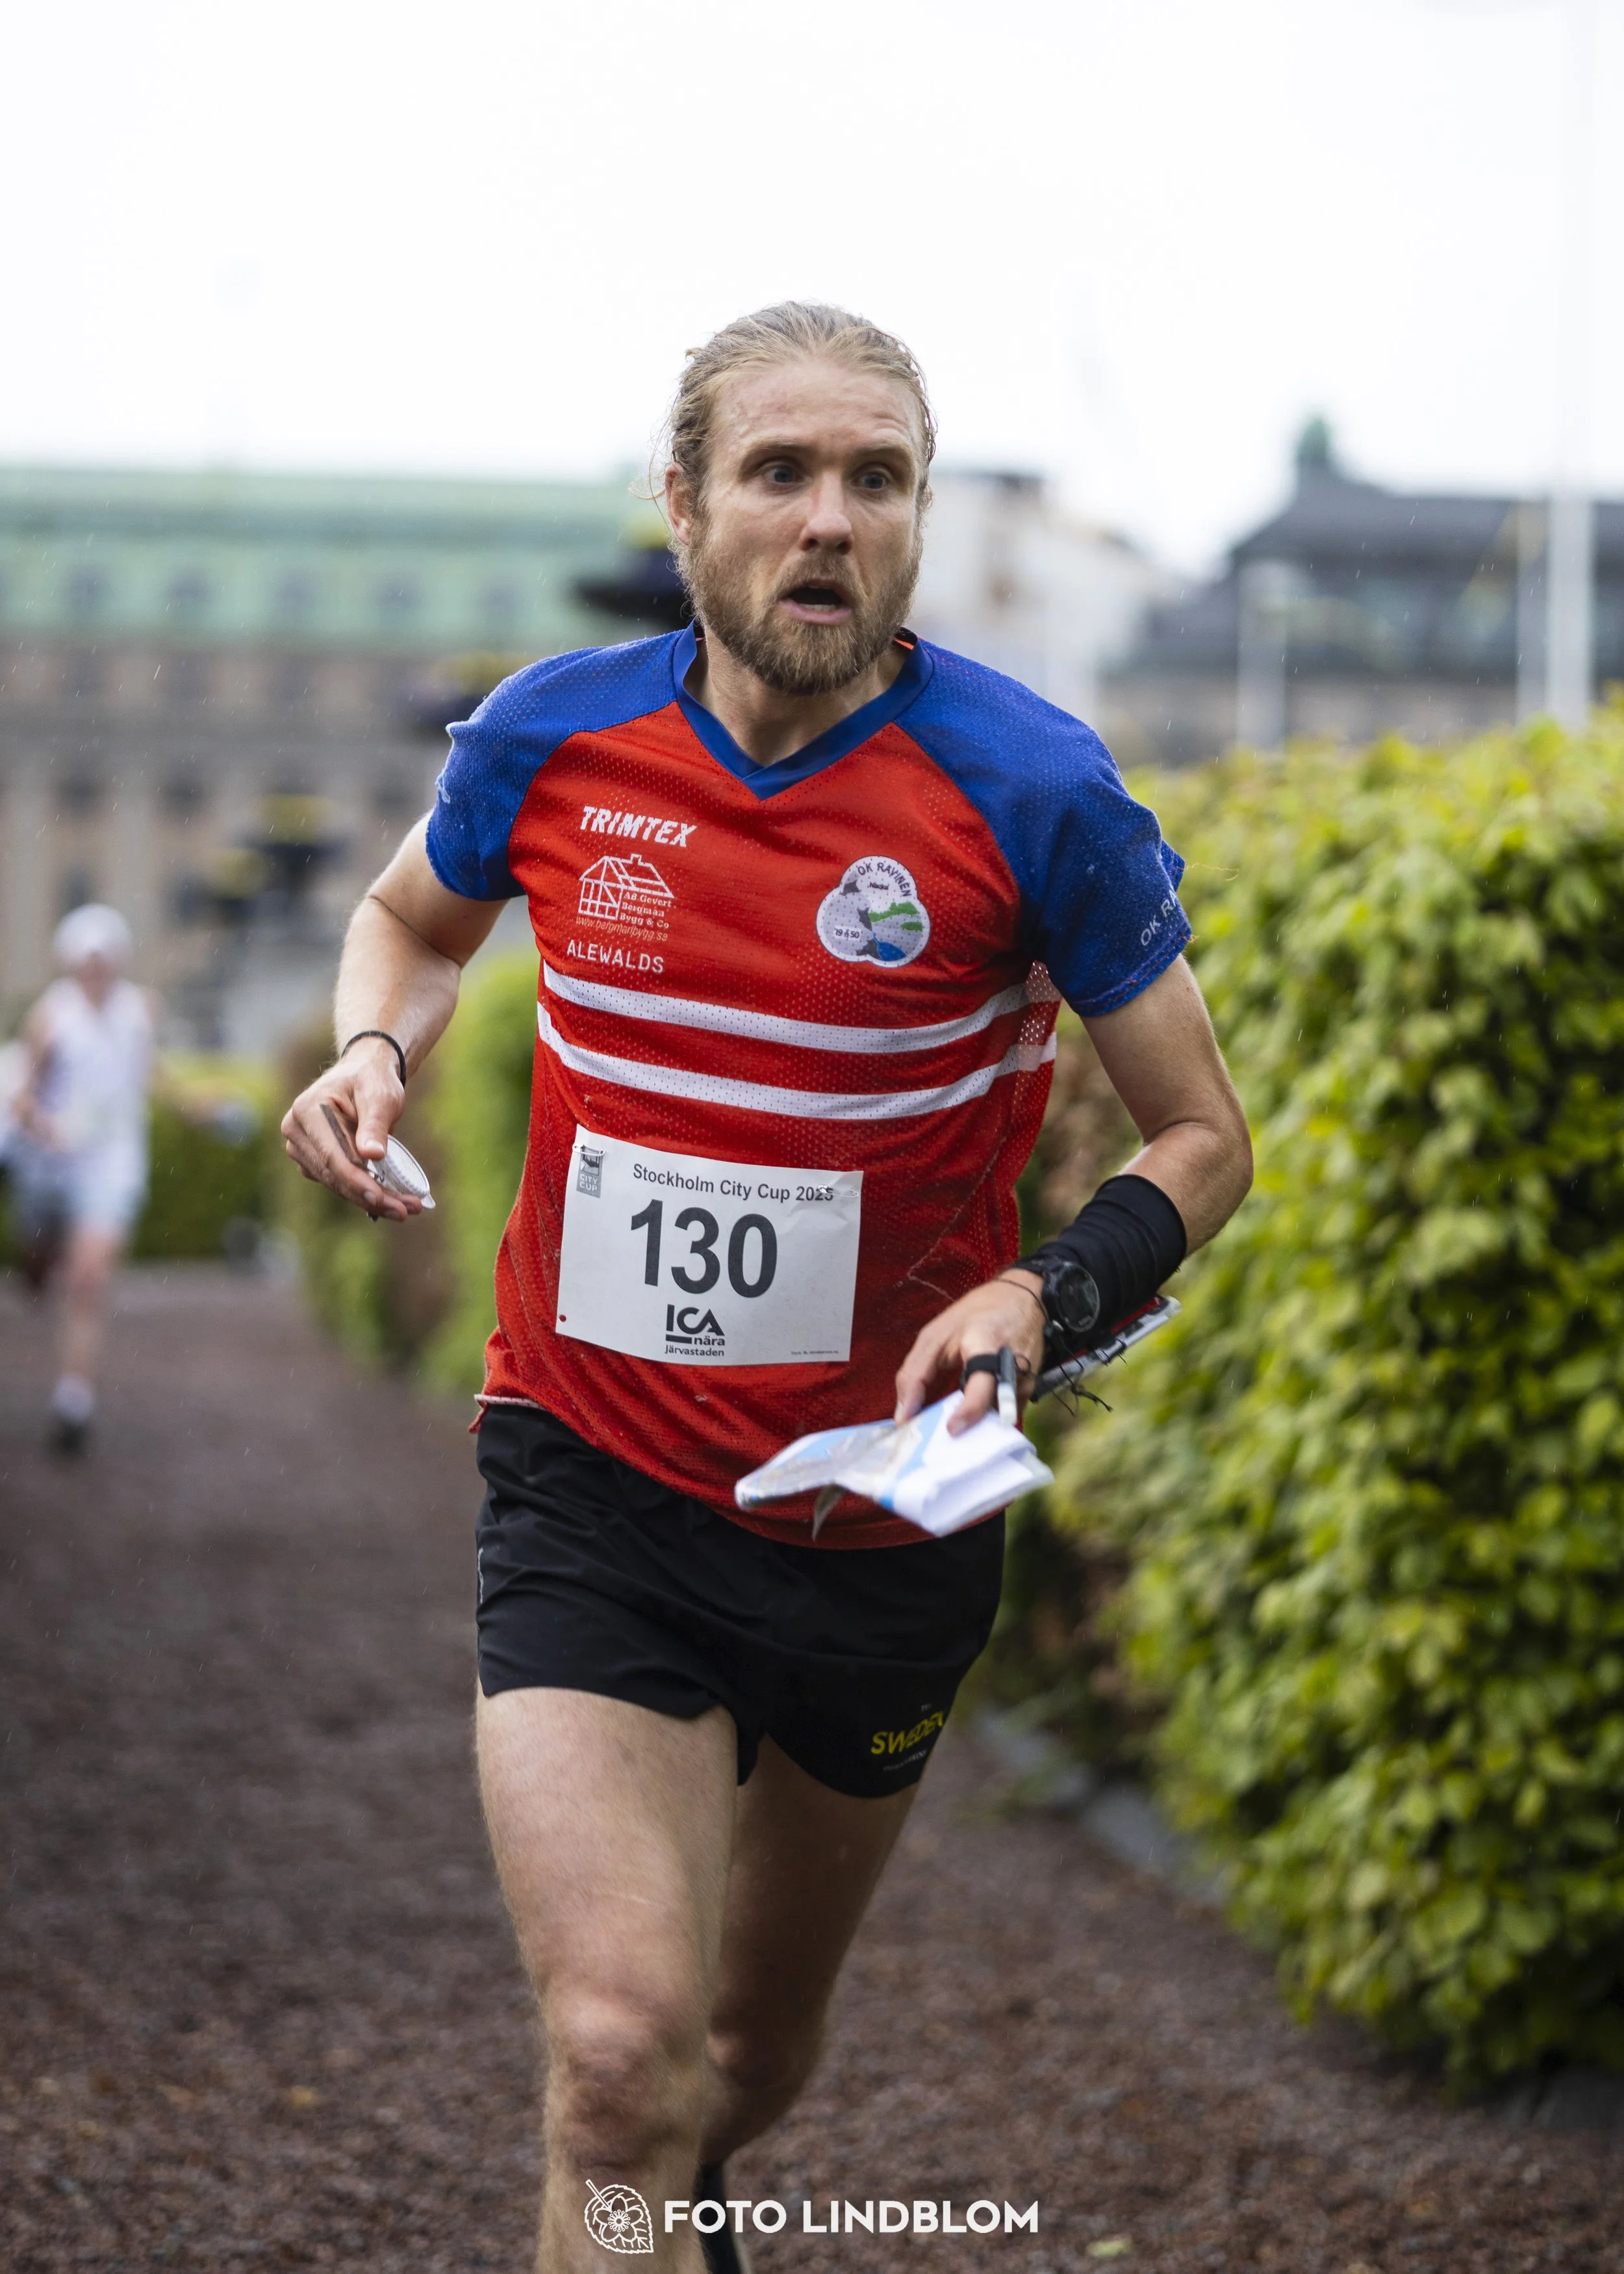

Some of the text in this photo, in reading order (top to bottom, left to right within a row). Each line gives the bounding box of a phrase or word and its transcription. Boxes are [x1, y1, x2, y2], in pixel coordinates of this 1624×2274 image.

[580, 806, 697, 847] TRIMTEX
[857, 862, 912, 897] OK RAVINEN
[622, 901, 665, 917] Bergman
[624, 891, 672, 908] AB Gevert
[620, 912, 670, 929] Bygg & Co
[1140, 914, 1161, 946] OK
[566, 939, 665, 974] ALEWALDS
[579, 1181, 598, 1192] CUP
[580, 1173, 598, 1184] CITY
[633, 1163, 715, 1193] Stockholm
[720, 1179, 752, 1201] City
[757, 1183, 791, 1203] Cup
[631, 1199, 778, 1298] 130
[666, 1303, 725, 1336] ICA
[665, 1344, 725, 1357] Järvastaden
[694, 1335, 726, 1346] nära
